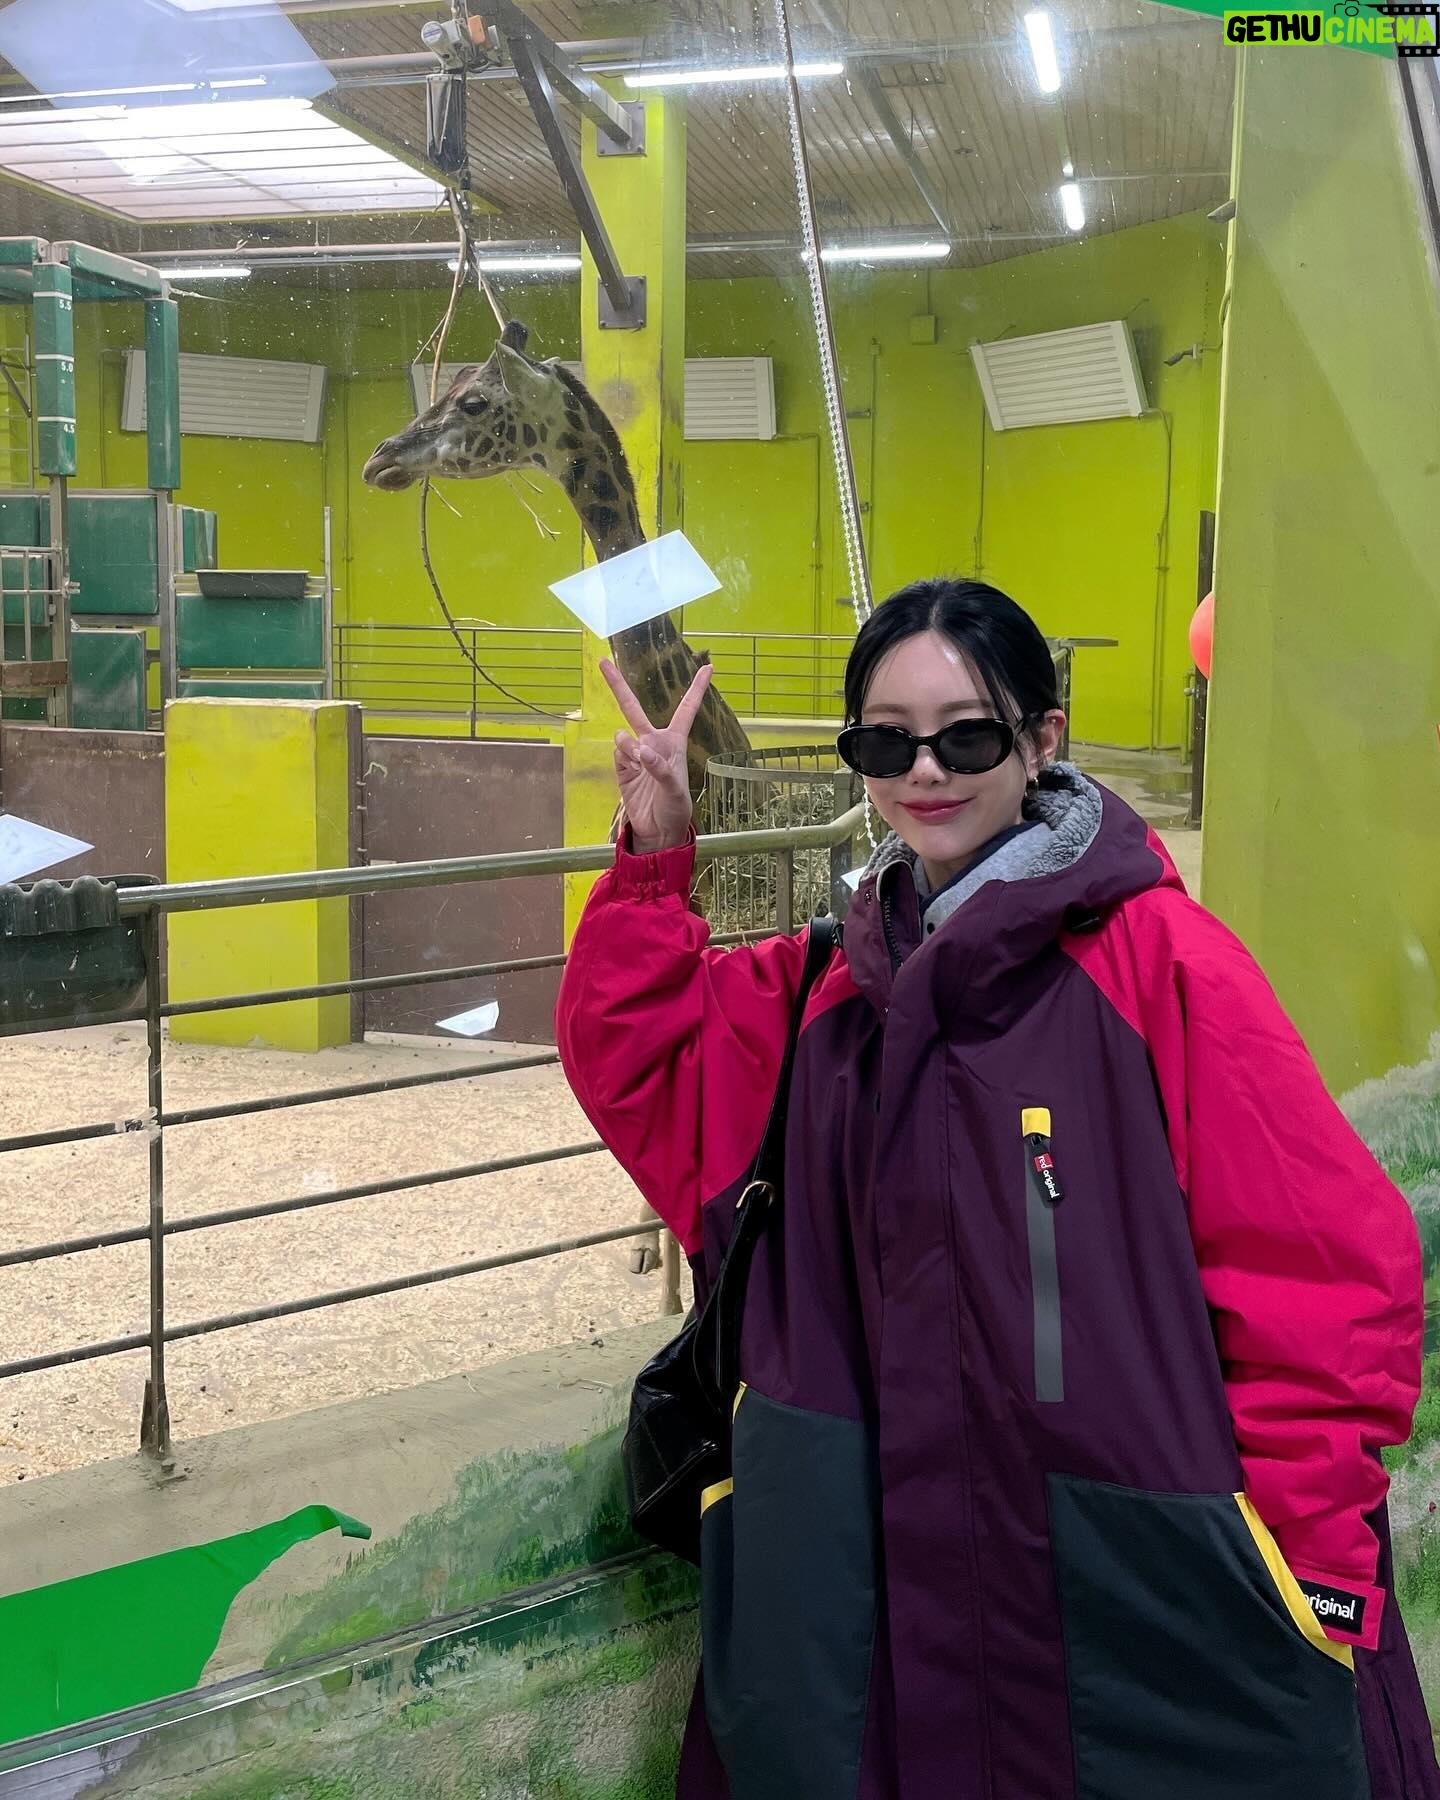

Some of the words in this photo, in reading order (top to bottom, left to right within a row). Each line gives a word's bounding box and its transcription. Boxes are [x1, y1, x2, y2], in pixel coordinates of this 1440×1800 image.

[59, 299, 72, 311] 5.5
[61, 361, 74, 373] 5.0
[63, 423, 75, 433] 4.5
[1038, 1155, 1054, 1169] red
[1043, 1170, 1060, 1198] original
